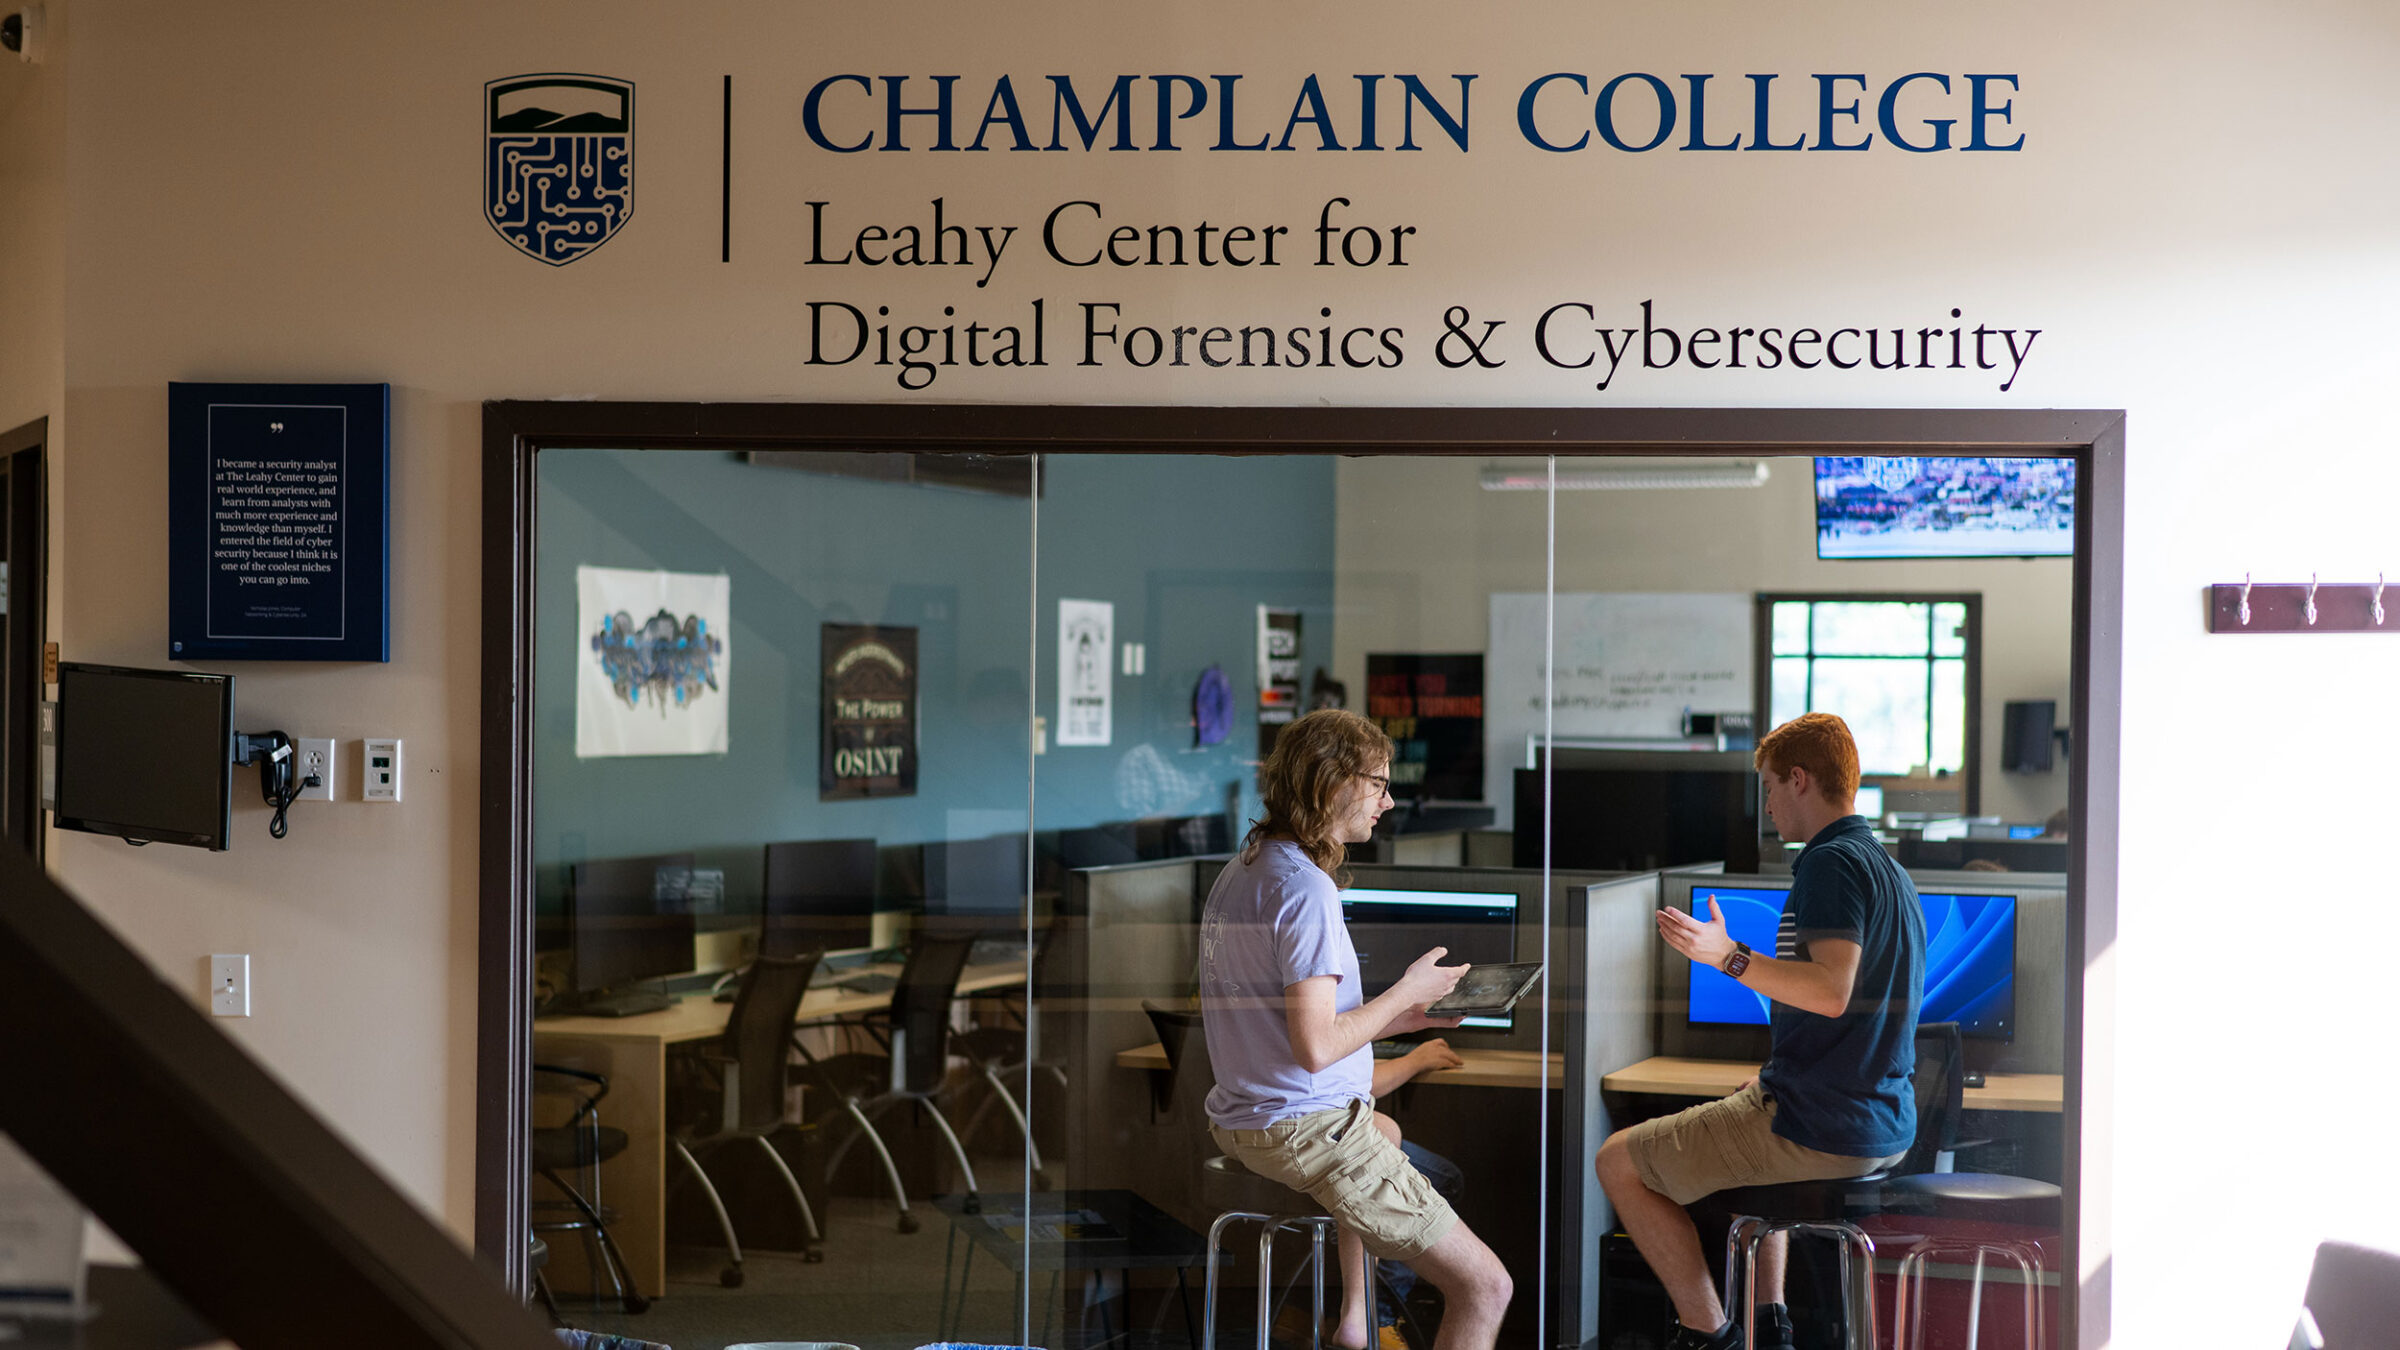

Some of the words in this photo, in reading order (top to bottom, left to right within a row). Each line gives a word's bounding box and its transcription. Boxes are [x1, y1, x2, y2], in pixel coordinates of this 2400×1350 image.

[801, 72, 1479, 154] CHAMPLAIN
[1516, 72, 2027, 154] COLLEGE
[803, 197, 1019, 289] Leahy
[1041, 200, 1288, 268] Center
[1313, 197, 1417, 268] for
[803, 298, 1049, 391] Digital
[1077, 301, 1405, 370] Forensics
[1433, 305, 1507, 369] &
[1533, 298, 2043, 392] Cybersecurity
[217, 459, 220, 468] I
[223, 459, 256, 468] became
[266, 460, 302, 471] security
[304, 461, 336, 471] analyst
[216, 473, 224, 481] at
[227, 472, 243, 481] The
[246, 472, 273, 483] Leahy
[275, 473, 305, 482] Center
[307, 474, 316, 482] to
[318, 474, 338, 484] gain
[217, 485, 234, 493] real
[237, 485, 263, 494] world
[266, 486, 317, 496] experience,
[319, 486, 336, 495] and
[222, 497, 245, 506] learn
[247, 498, 270, 507] from
[272, 498, 308, 509] analysts
[310, 499, 331, 508] with
[216, 510, 241, 519] much
[269, 512, 318, 523] experience
[320, 512, 337, 520] and
[220, 523, 269, 534] knowledge
[271, 524, 292, 533] than
[294, 525, 326, 535] myself.
[329, 525, 332, 533] I
[220, 536, 254, 545] entered
[257, 536, 271, 545] the
[273, 536, 293, 546] field
[295, 537, 305, 546] of
[306, 537, 332, 548] cyber
[215, 549, 251, 560] security
[253, 549, 288, 558] because
[290, 550, 294, 558] I
[296, 550, 319, 559] think
[322, 550, 328, 559] it
[330, 550, 338, 559] is
[221, 563, 238, 571] one
[240, 562, 250, 571] of
[252, 562, 266, 571] the
[268, 562, 299, 571] coolest
[302, 563, 331, 572] niches
[239, 577, 256, 586] you
[276, 577, 288, 588] go
[290, 576, 310, 584] into.
